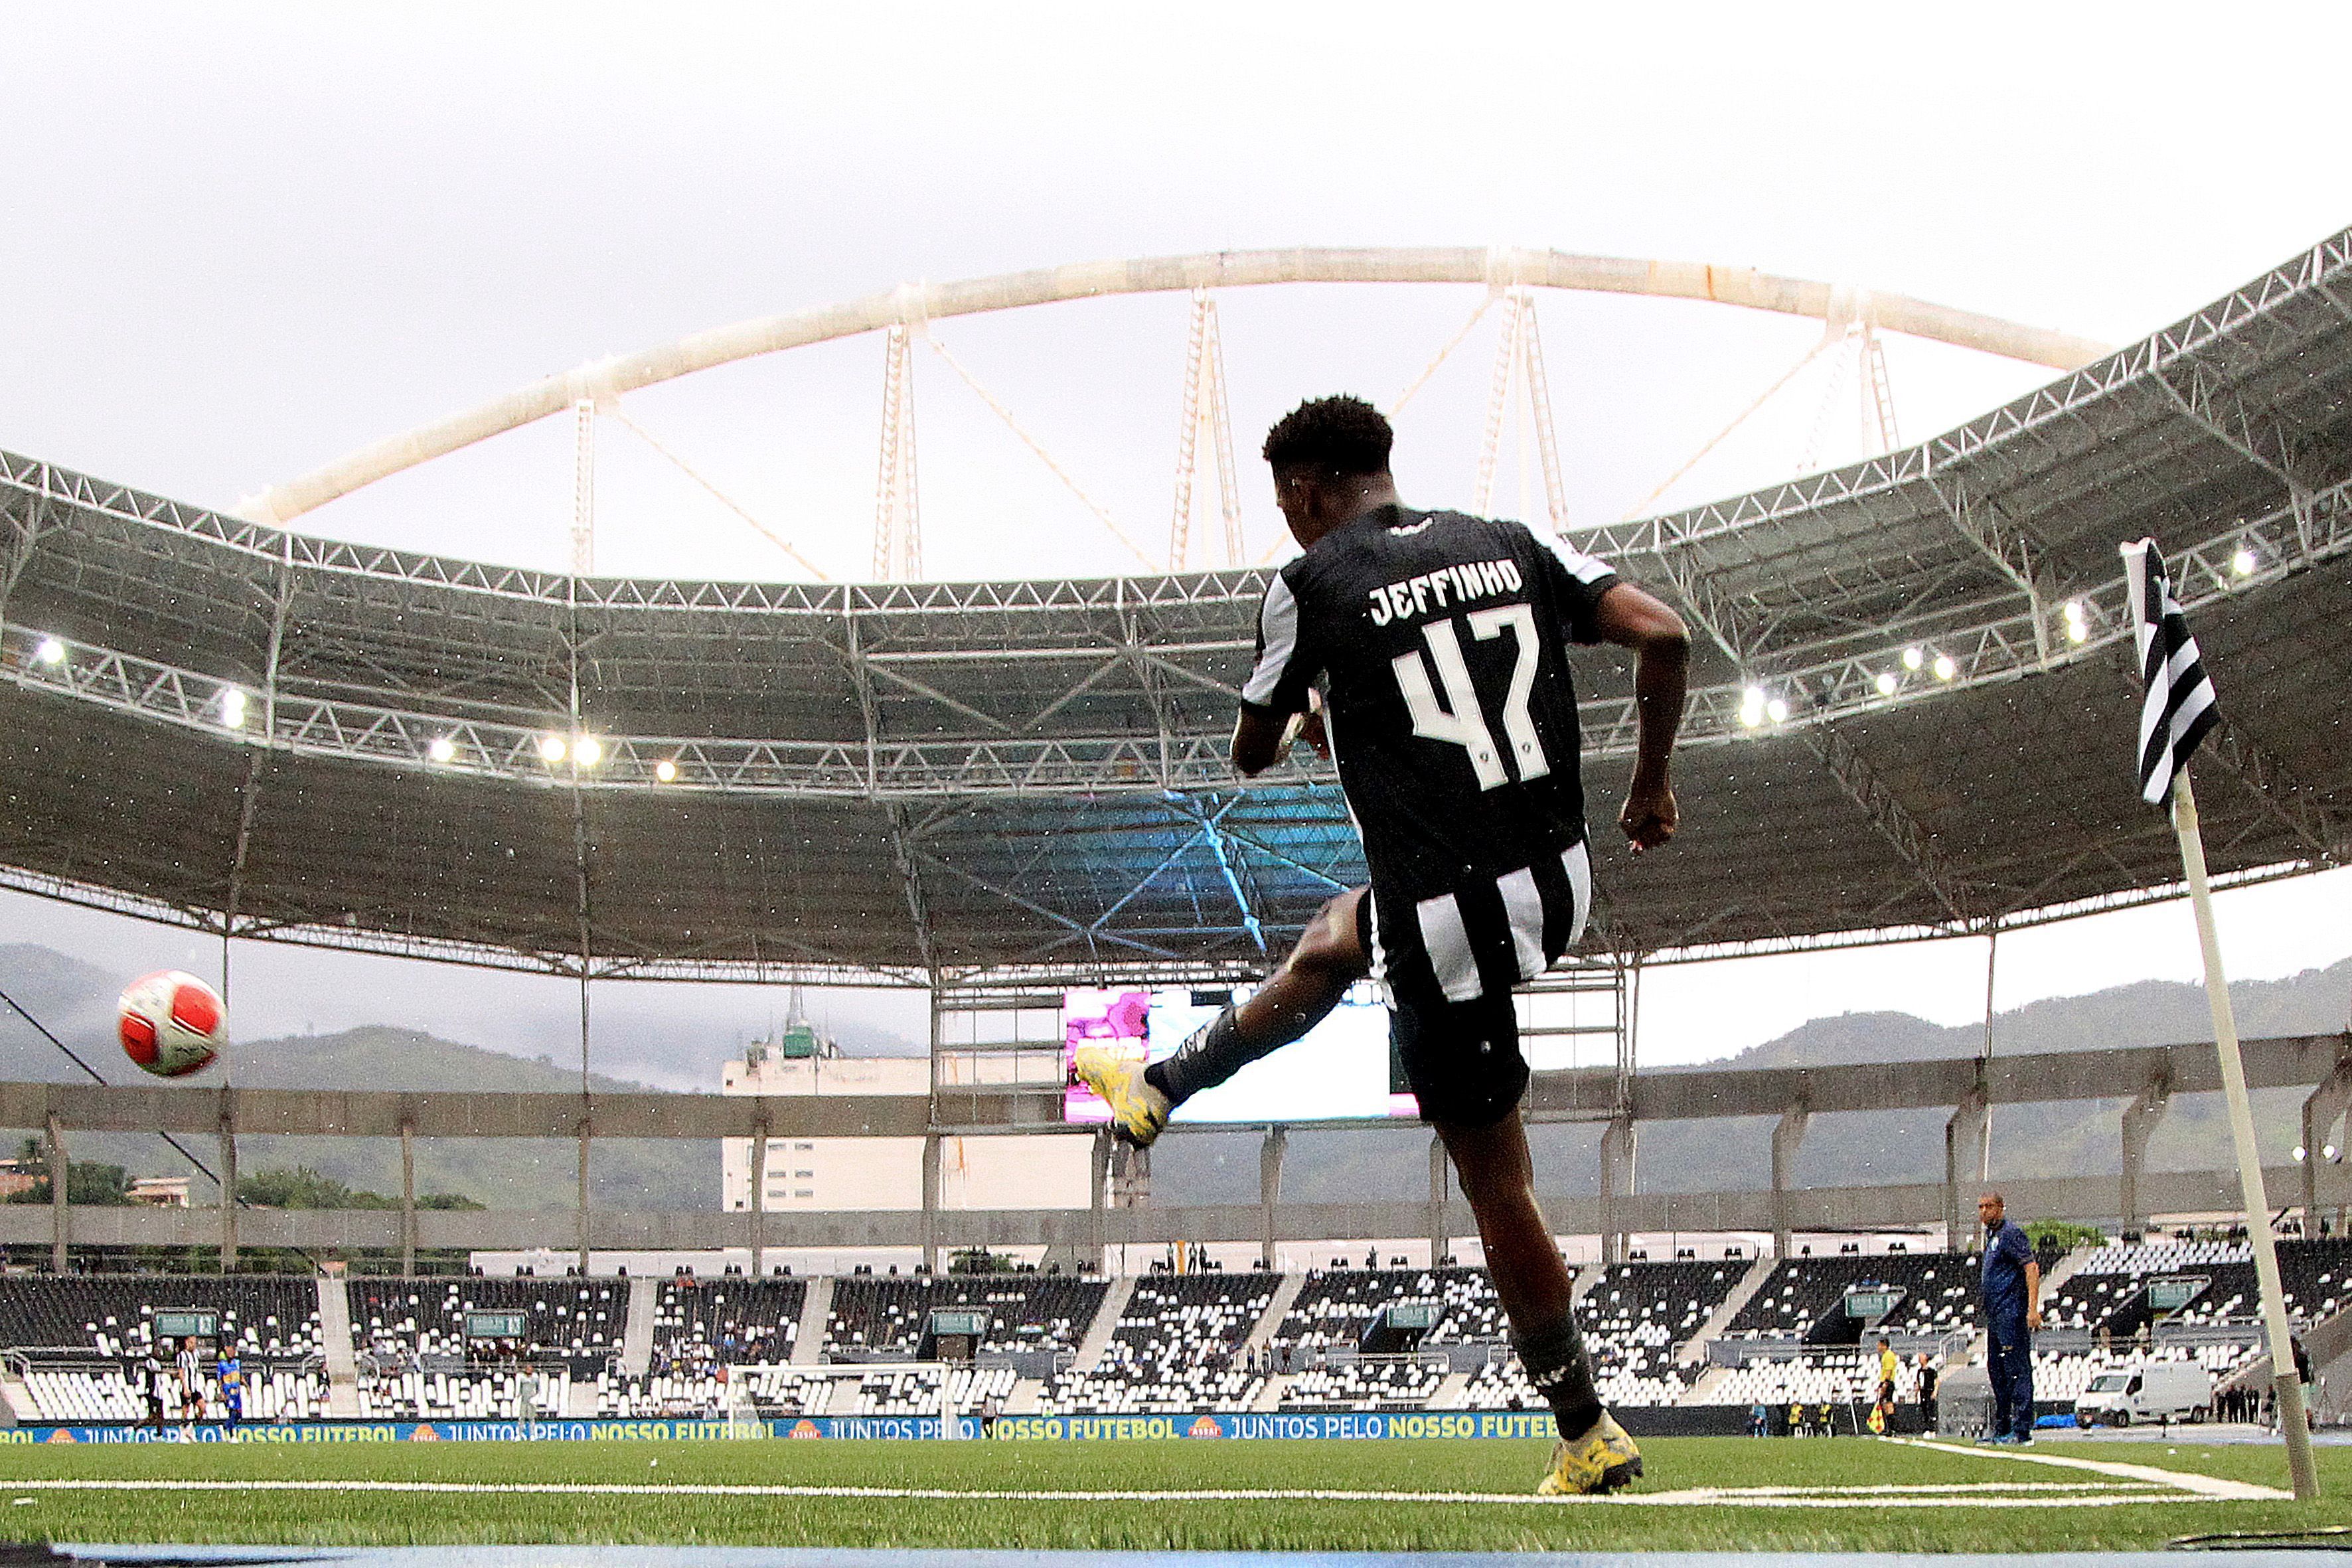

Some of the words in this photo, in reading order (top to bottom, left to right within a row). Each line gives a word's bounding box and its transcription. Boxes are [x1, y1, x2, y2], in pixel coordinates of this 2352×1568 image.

[1369, 559, 1523, 626] JEFFINHO
[1391, 603, 1551, 792] 47
[591, 1423, 670, 1440] NOSSO
[830, 1420, 913, 1440] JUNTOS
[1069, 1419, 1180, 1440] FUTEBOL
[1231, 1417, 1318, 1439] JUNTOS
[1326, 1417, 1382, 1439] PELO
[1389, 1416, 1474, 1439] NOSSO
